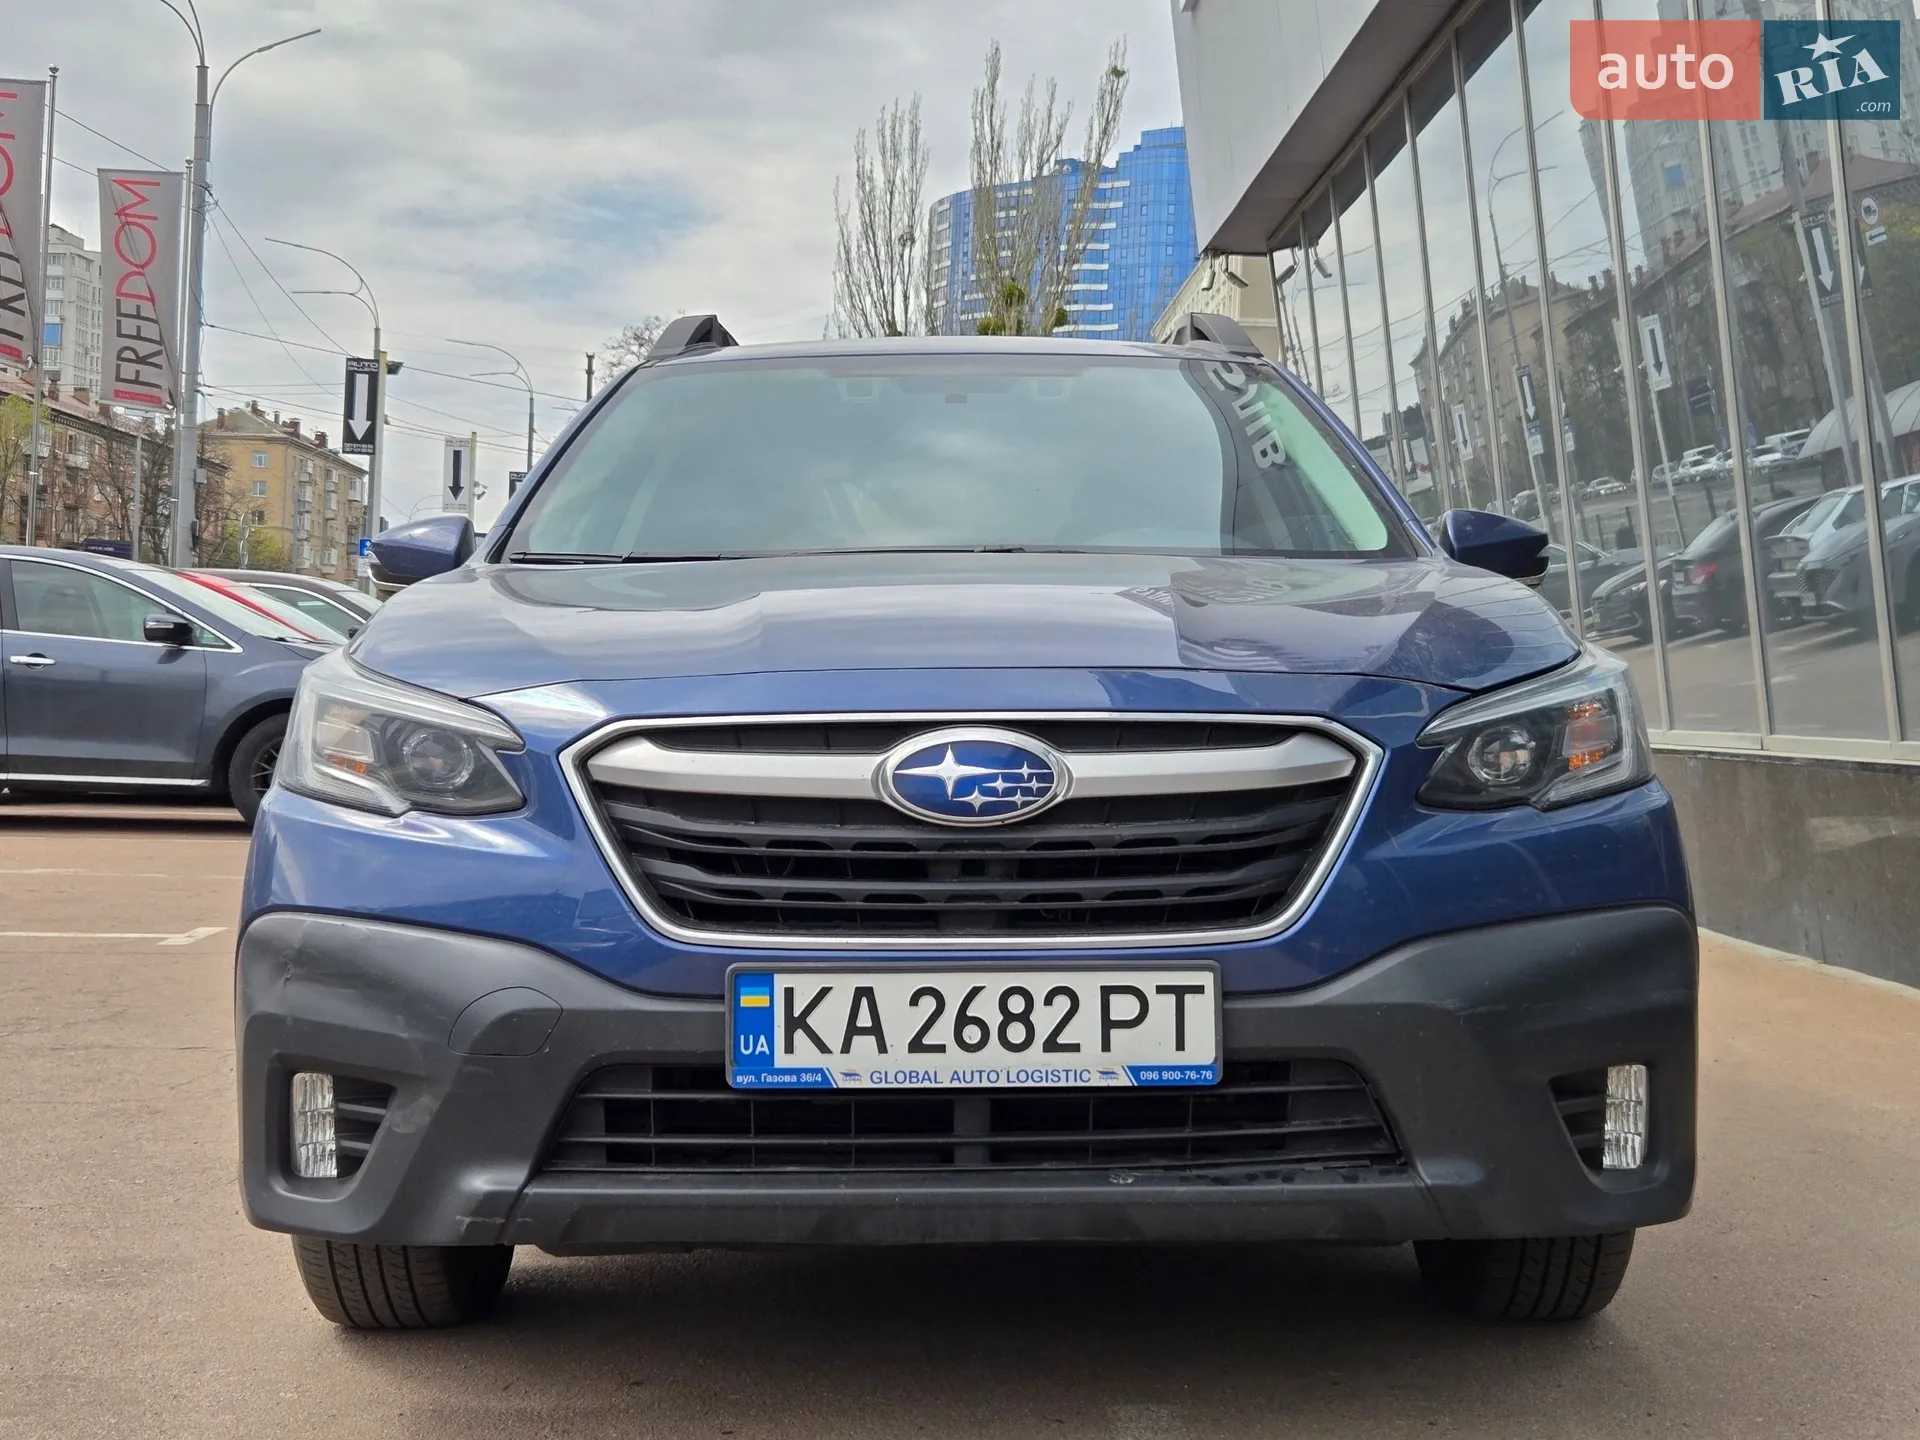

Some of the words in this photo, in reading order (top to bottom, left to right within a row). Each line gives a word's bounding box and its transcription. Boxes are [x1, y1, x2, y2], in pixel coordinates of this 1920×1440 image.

[783, 985, 888, 1054] KA
[907, 985, 1081, 1054] 2682
[1100, 984, 1205, 1053] PT
[740, 1035, 769, 1055] UA
[736, 1074, 758, 1083] вул.
[761, 1073, 797, 1083] Газова
[800, 1073, 822, 1083] 36/4
[870, 1070, 943, 1084] GLOBAL
[949, 1070, 1000, 1084] AUTO
[1006, 1069, 1091, 1083] LOGISTIC
[1140, 1071, 1159, 1080] 096
[1161, 1070, 1212, 1080] 900-76-76
